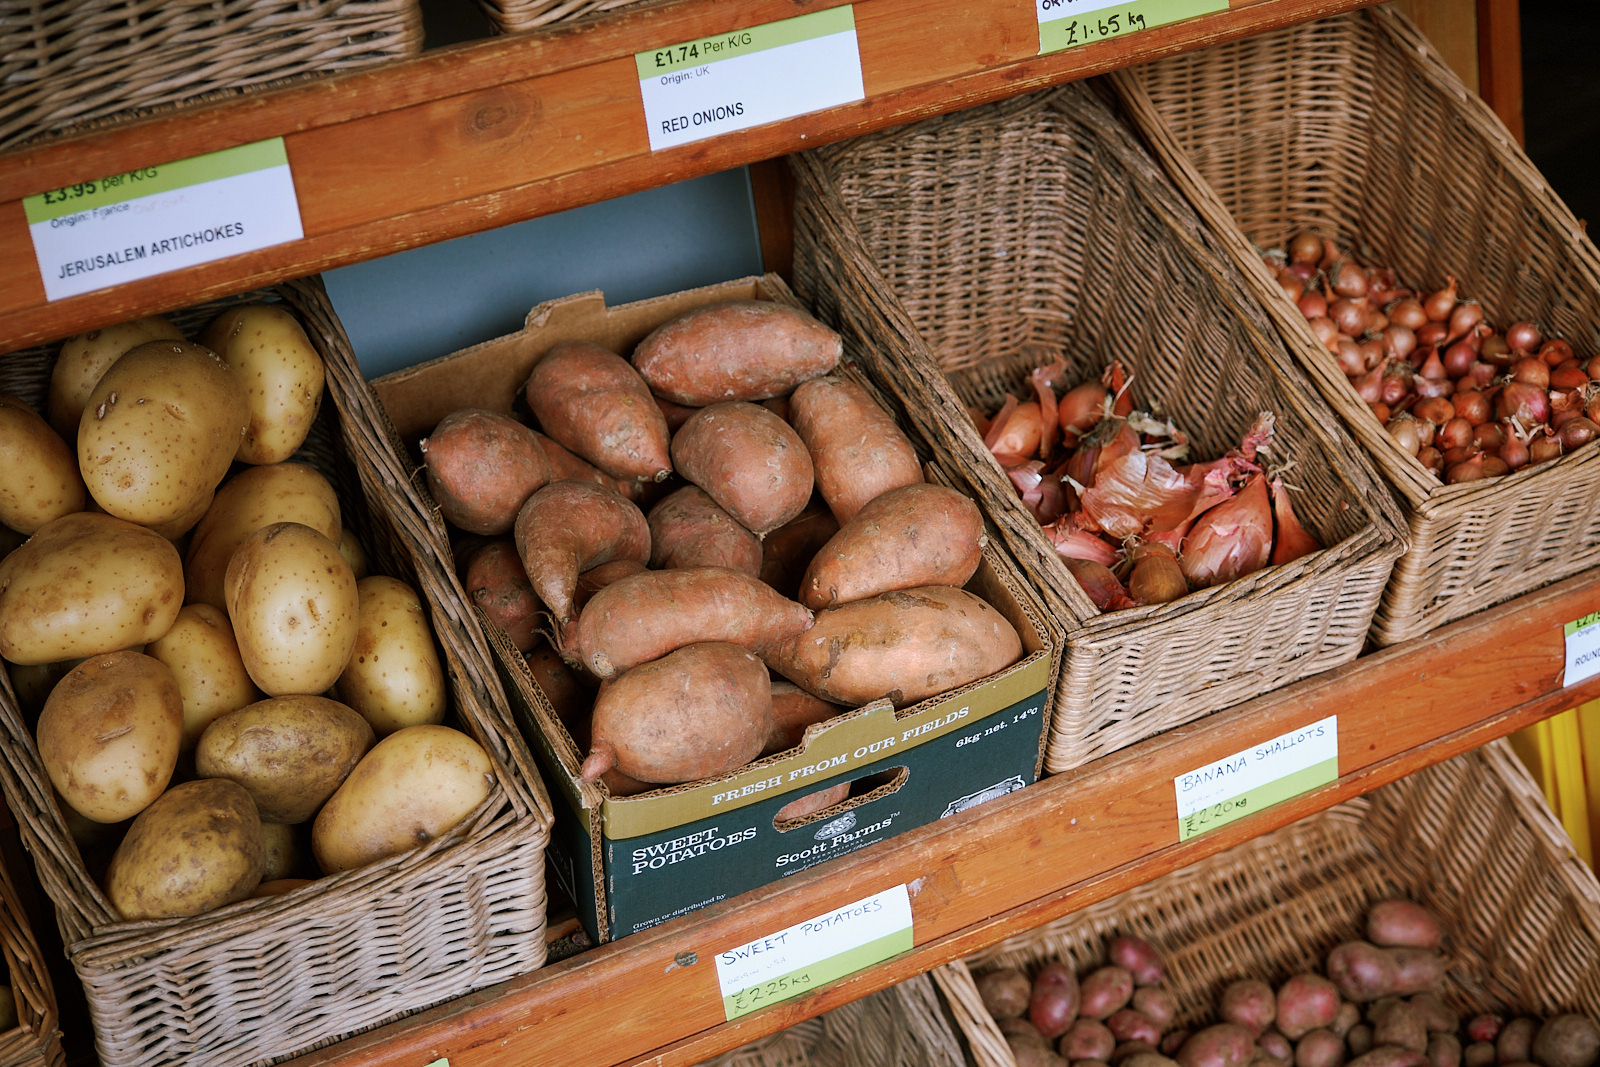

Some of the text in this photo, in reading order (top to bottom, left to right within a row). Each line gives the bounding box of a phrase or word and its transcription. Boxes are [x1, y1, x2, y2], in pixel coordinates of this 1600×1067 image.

[1065, 12, 1146, 45] £1.65 kg
[655, 32, 752, 67] £1.74 Per K/G
[660, 66, 710, 86] Origin: UK
[661, 102, 744, 135] RED ONIONS
[101, 175, 125, 192] per
[130, 167, 158, 183] K/G
[51, 213, 91, 229] Origin:
[58, 222, 245, 279] JERUSALEM ARTICHOKES
[955, 732, 982, 749] 6kg
[984, 719, 1009, 736] net.
[711, 705, 970, 806] FRESH FROM OUR FIELDS
[1181, 725, 1325, 792] BANANA SHALLOTS
[632, 826, 719, 862] SWEET
[632, 826, 758, 876] POTATOES
[775, 841, 828, 868] Scott
[831, 817, 893, 849] Farms
[632, 916, 660, 930] Grown
[672, 896, 715, 916] distributed
[716, 893, 727, 901] by
[722, 898, 883, 966] SWEET POTATOES
